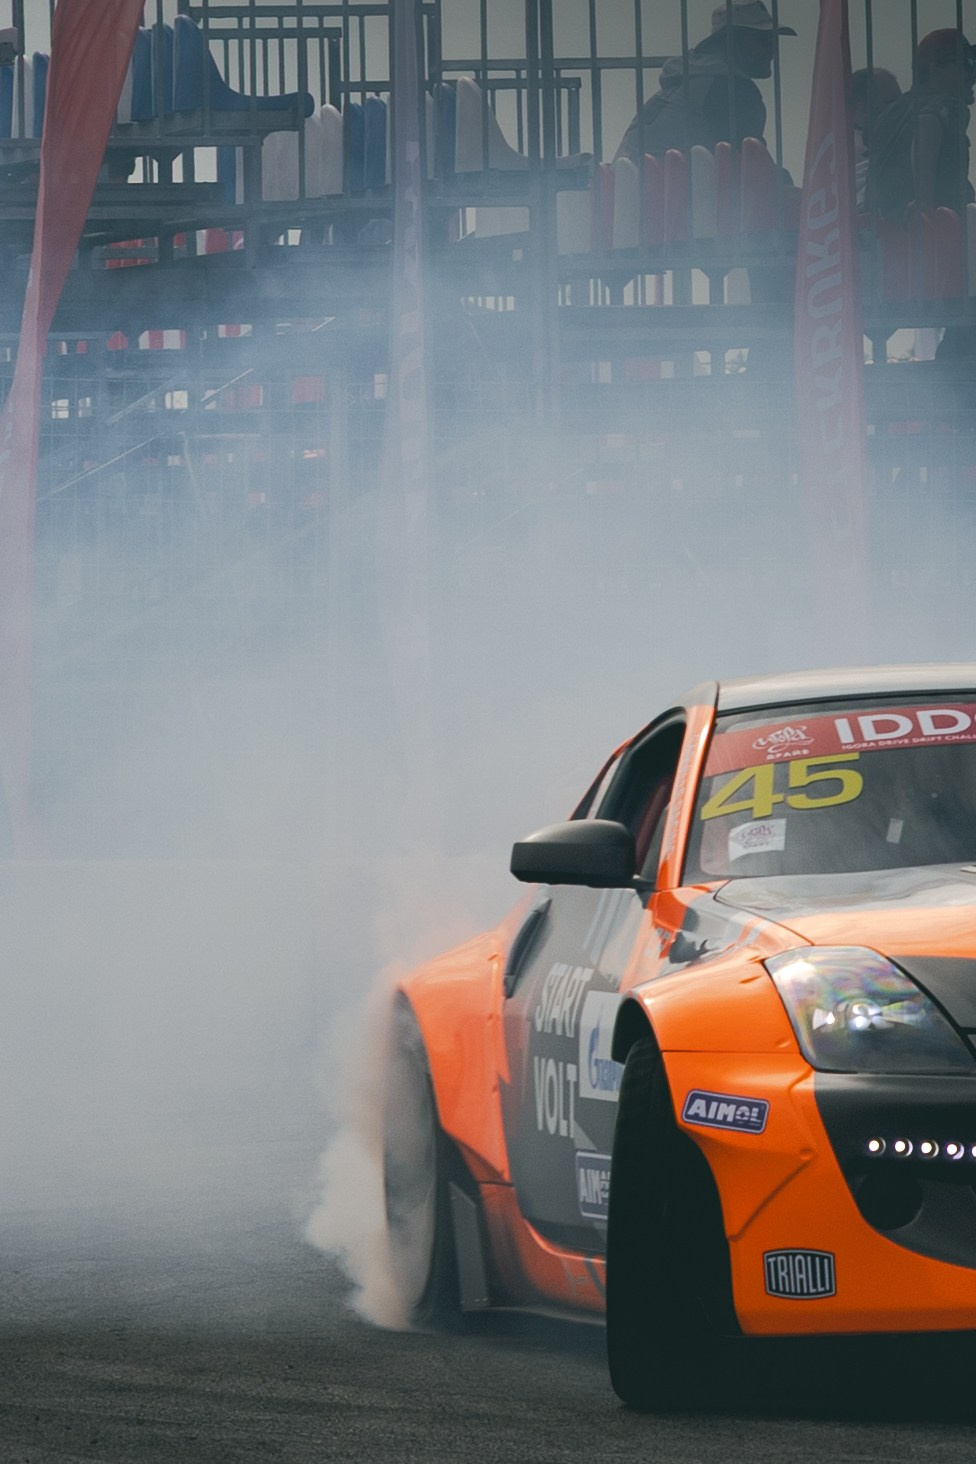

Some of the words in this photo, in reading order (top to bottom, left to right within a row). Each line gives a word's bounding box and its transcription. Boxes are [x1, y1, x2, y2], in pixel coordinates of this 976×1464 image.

[841, 741, 877, 751] IGORA
[878, 737, 911, 747] DRIVE
[911, 735, 943, 744] DRIFT
[700, 751, 865, 822] 45
[534, 961, 595, 1039] START
[532, 1055, 578, 1140] VOLT
[686, 1098, 762, 1124] AIMOL
[579, 1167, 611, 1206] AIMO
[766, 1254, 832, 1295] TRIALLI
